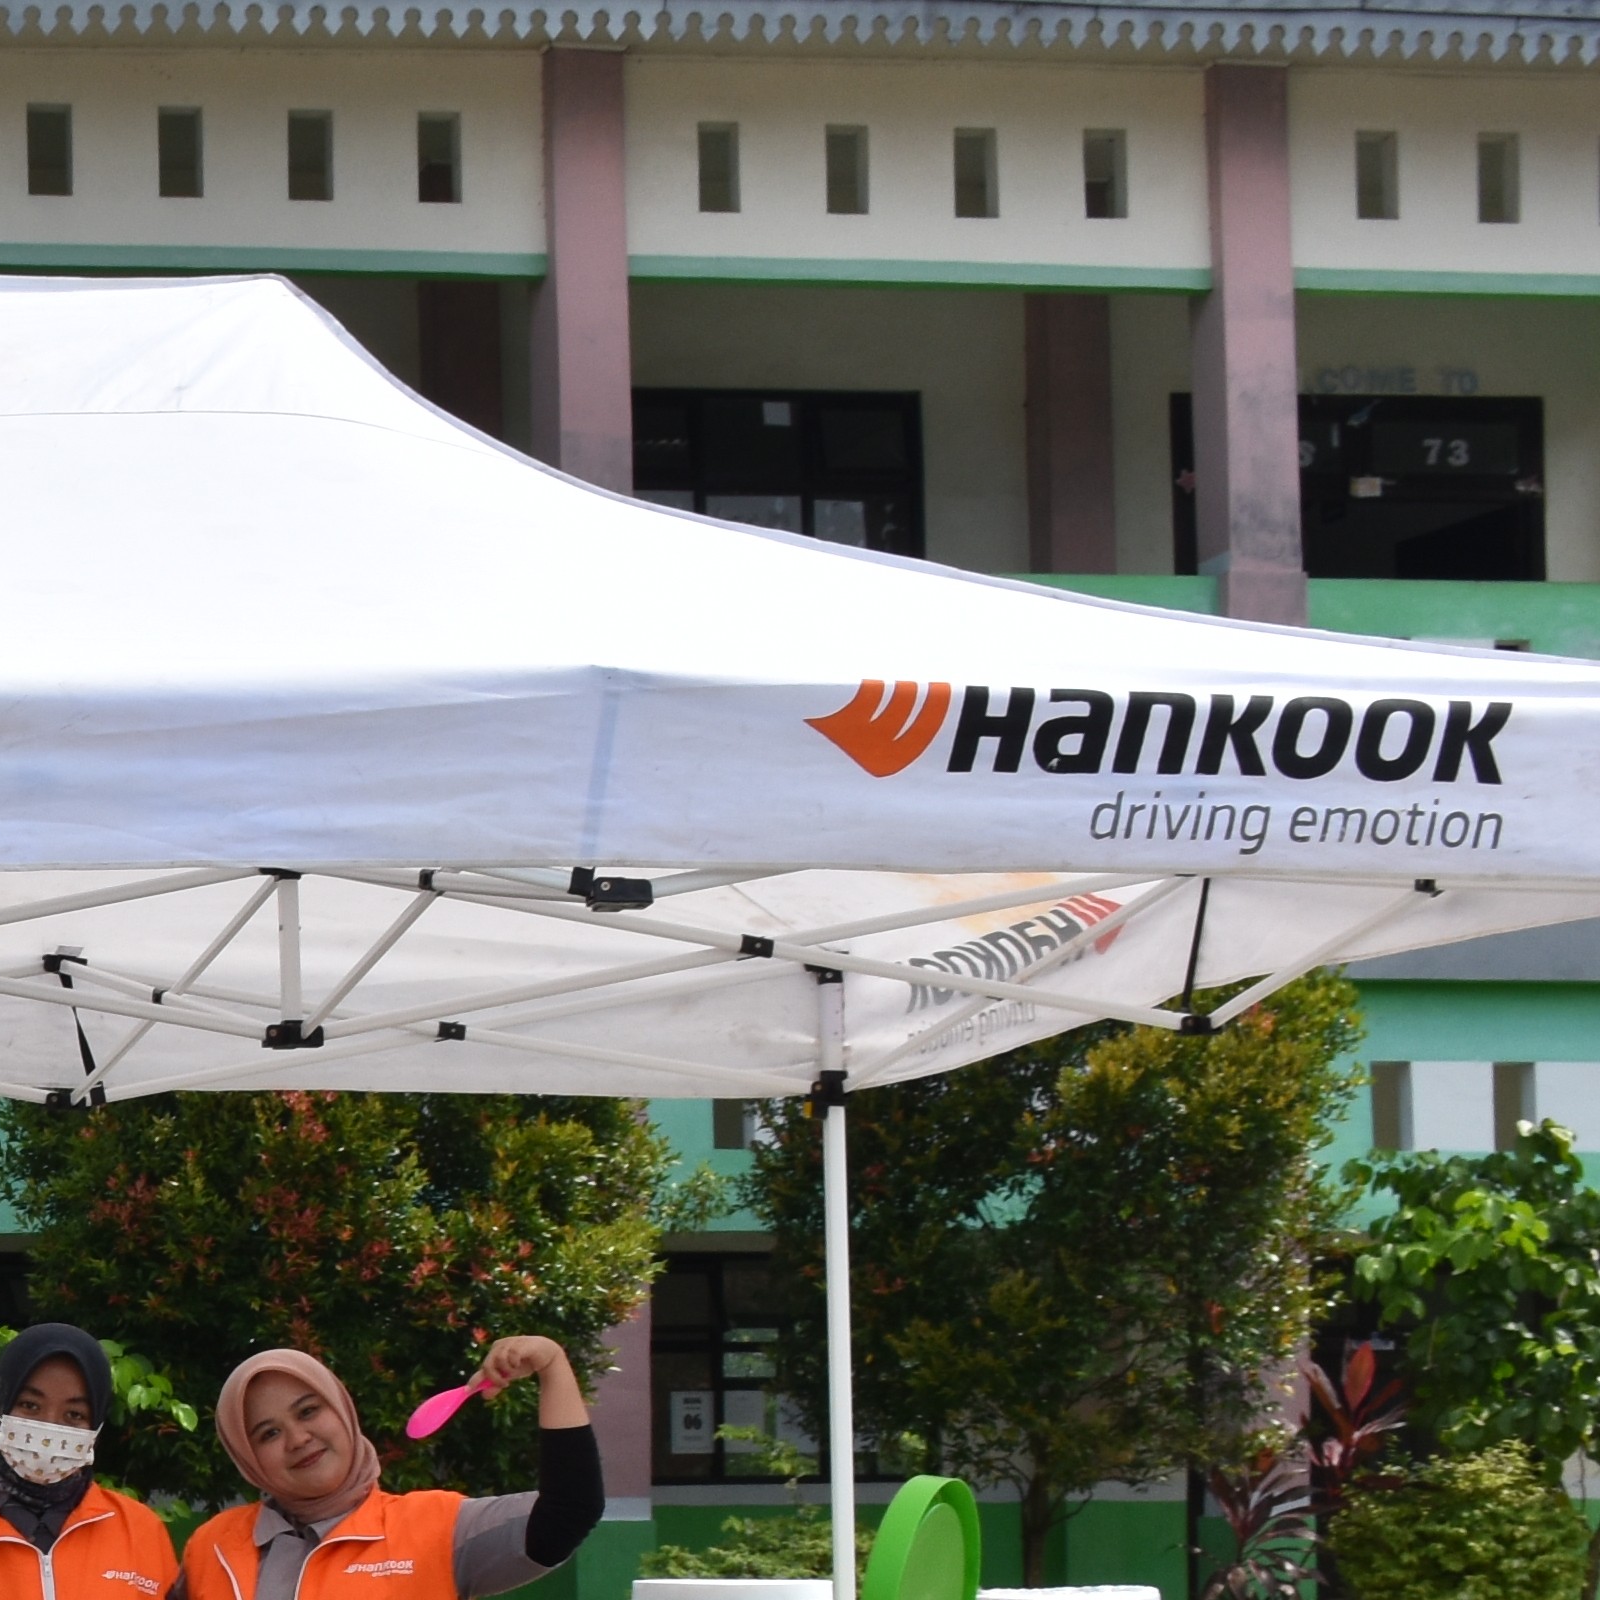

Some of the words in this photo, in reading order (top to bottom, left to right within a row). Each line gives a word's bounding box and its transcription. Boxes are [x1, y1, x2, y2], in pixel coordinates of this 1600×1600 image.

[1422, 438, 1470, 467] 73
[946, 685, 1513, 785] Hankook
[1089, 790, 1271, 855] driving
[1288, 799, 1505, 850] emotion
